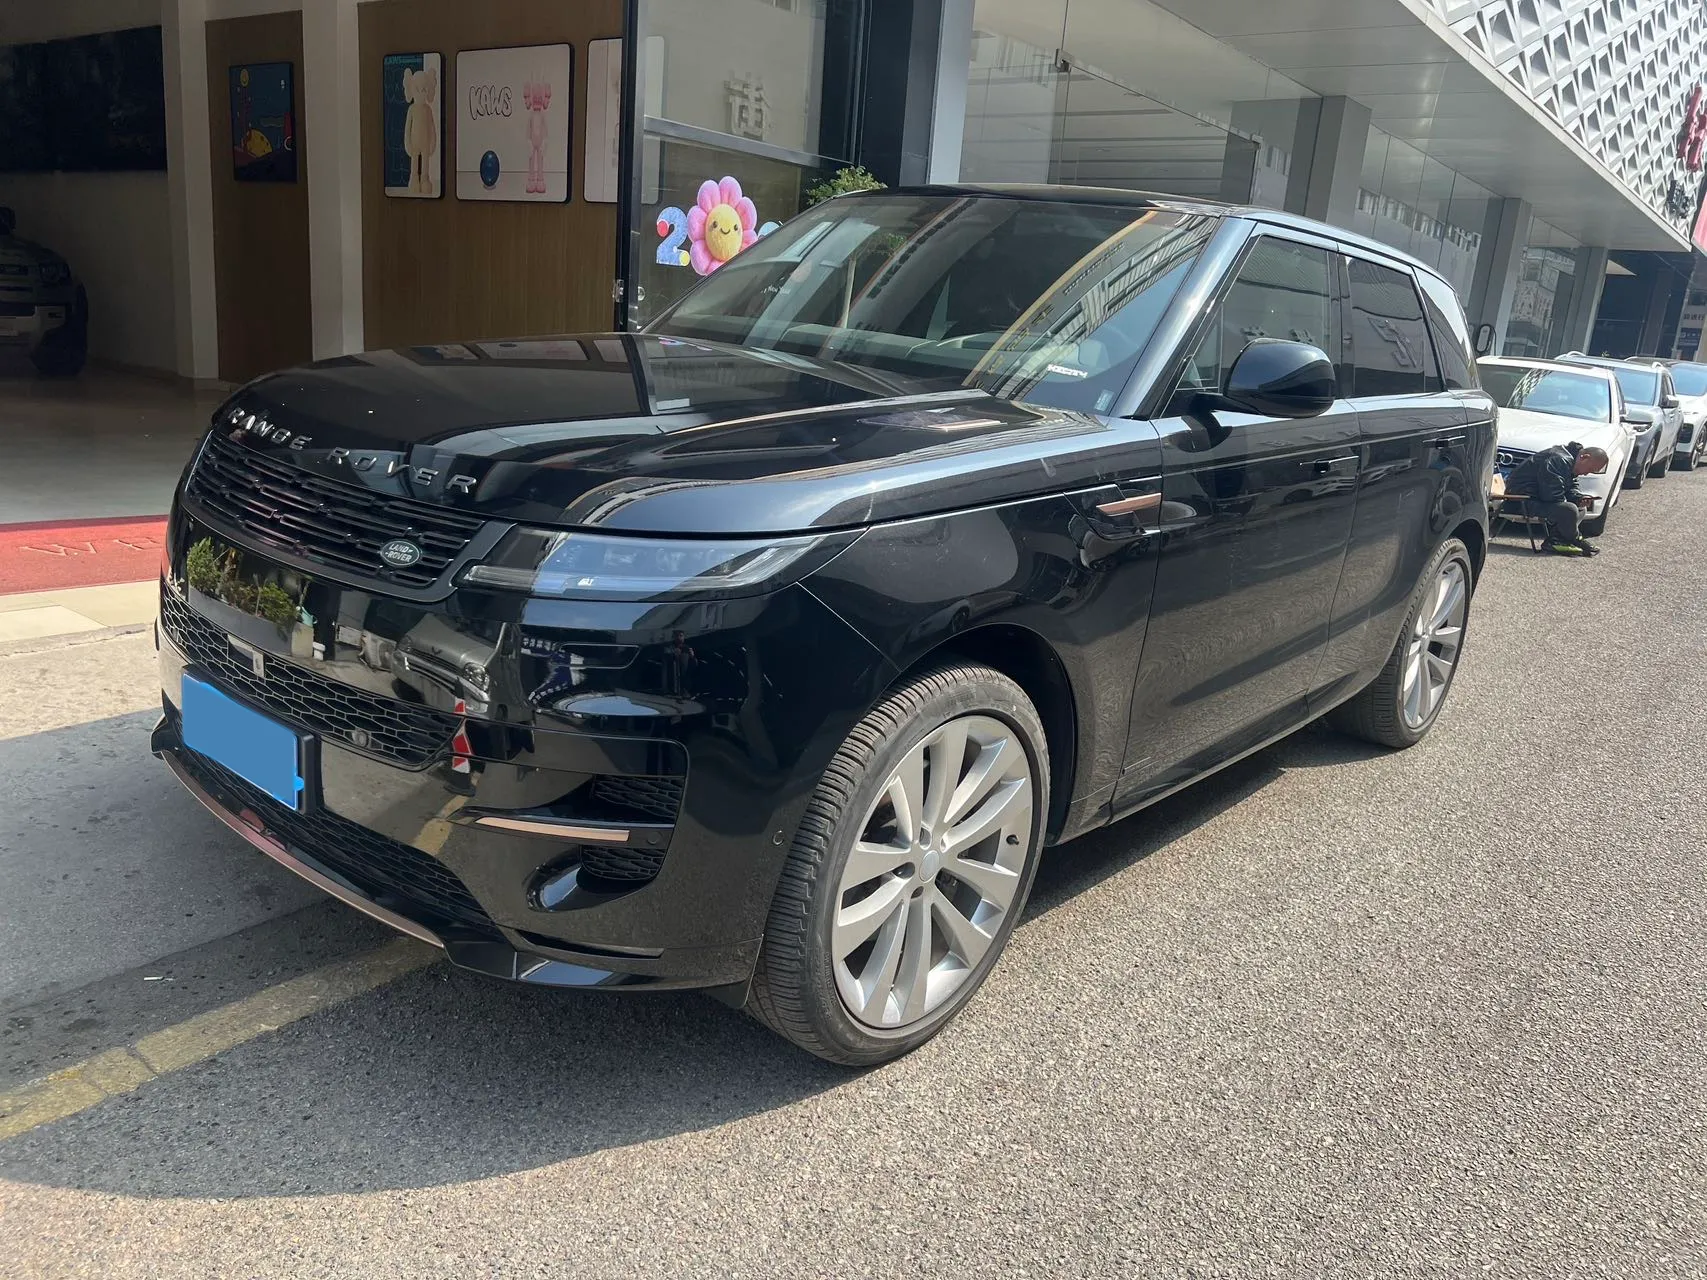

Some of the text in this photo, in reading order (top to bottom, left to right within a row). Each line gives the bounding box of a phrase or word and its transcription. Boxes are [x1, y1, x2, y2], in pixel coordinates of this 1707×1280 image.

[469, 85, 512, 120] KAWS
[228, 407, 477, 494] RANGE ROVER
[388, 551, 412, 562] ROVER
